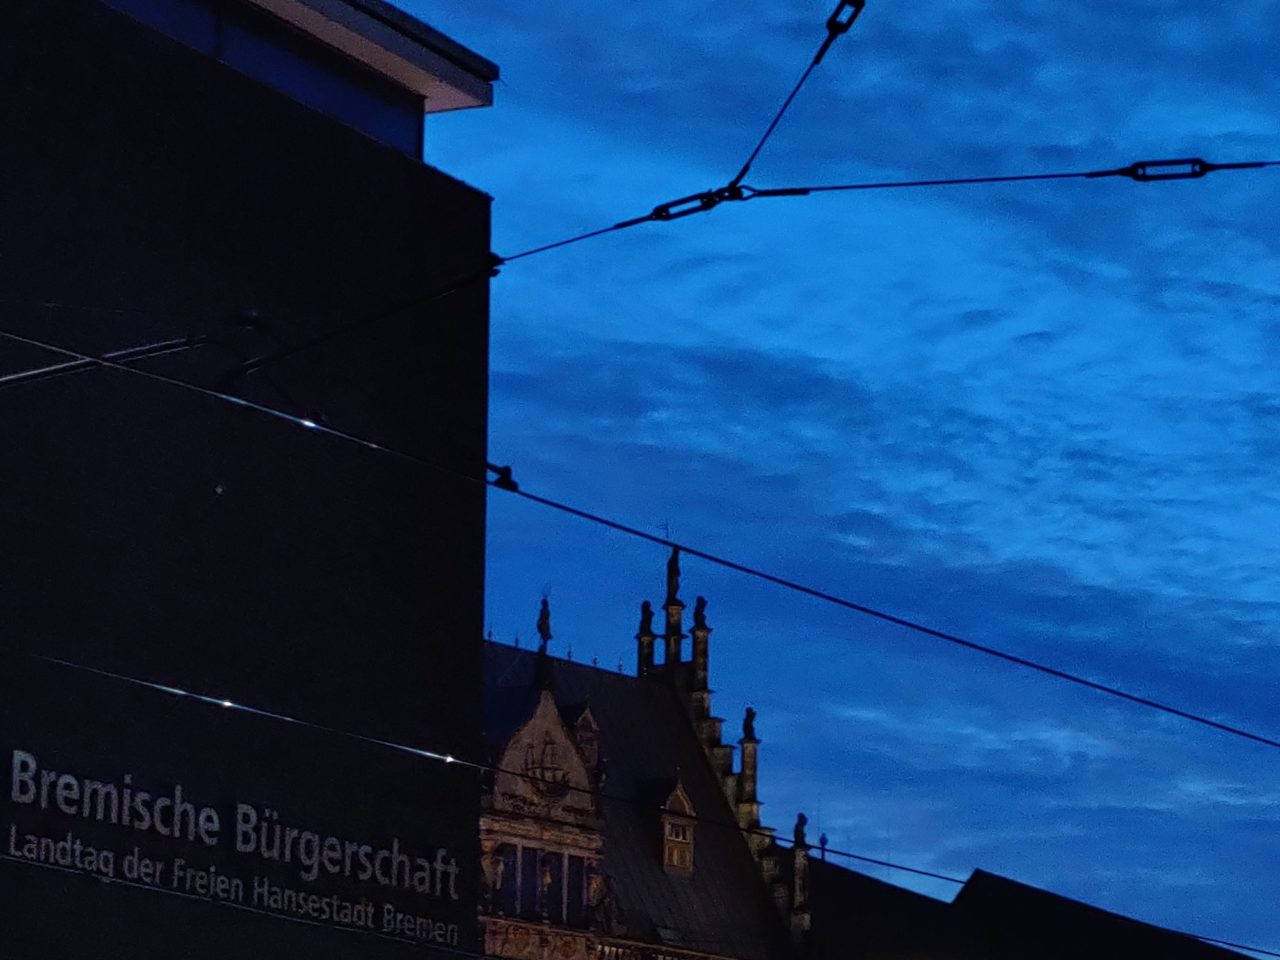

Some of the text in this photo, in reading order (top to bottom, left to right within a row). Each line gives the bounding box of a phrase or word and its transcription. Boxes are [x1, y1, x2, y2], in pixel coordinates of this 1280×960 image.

[8, 824, 459, 947] Landtag der Freien Hansestadt Bremen
[11, 749, 461, 900] Bremische Bürgerschaft
